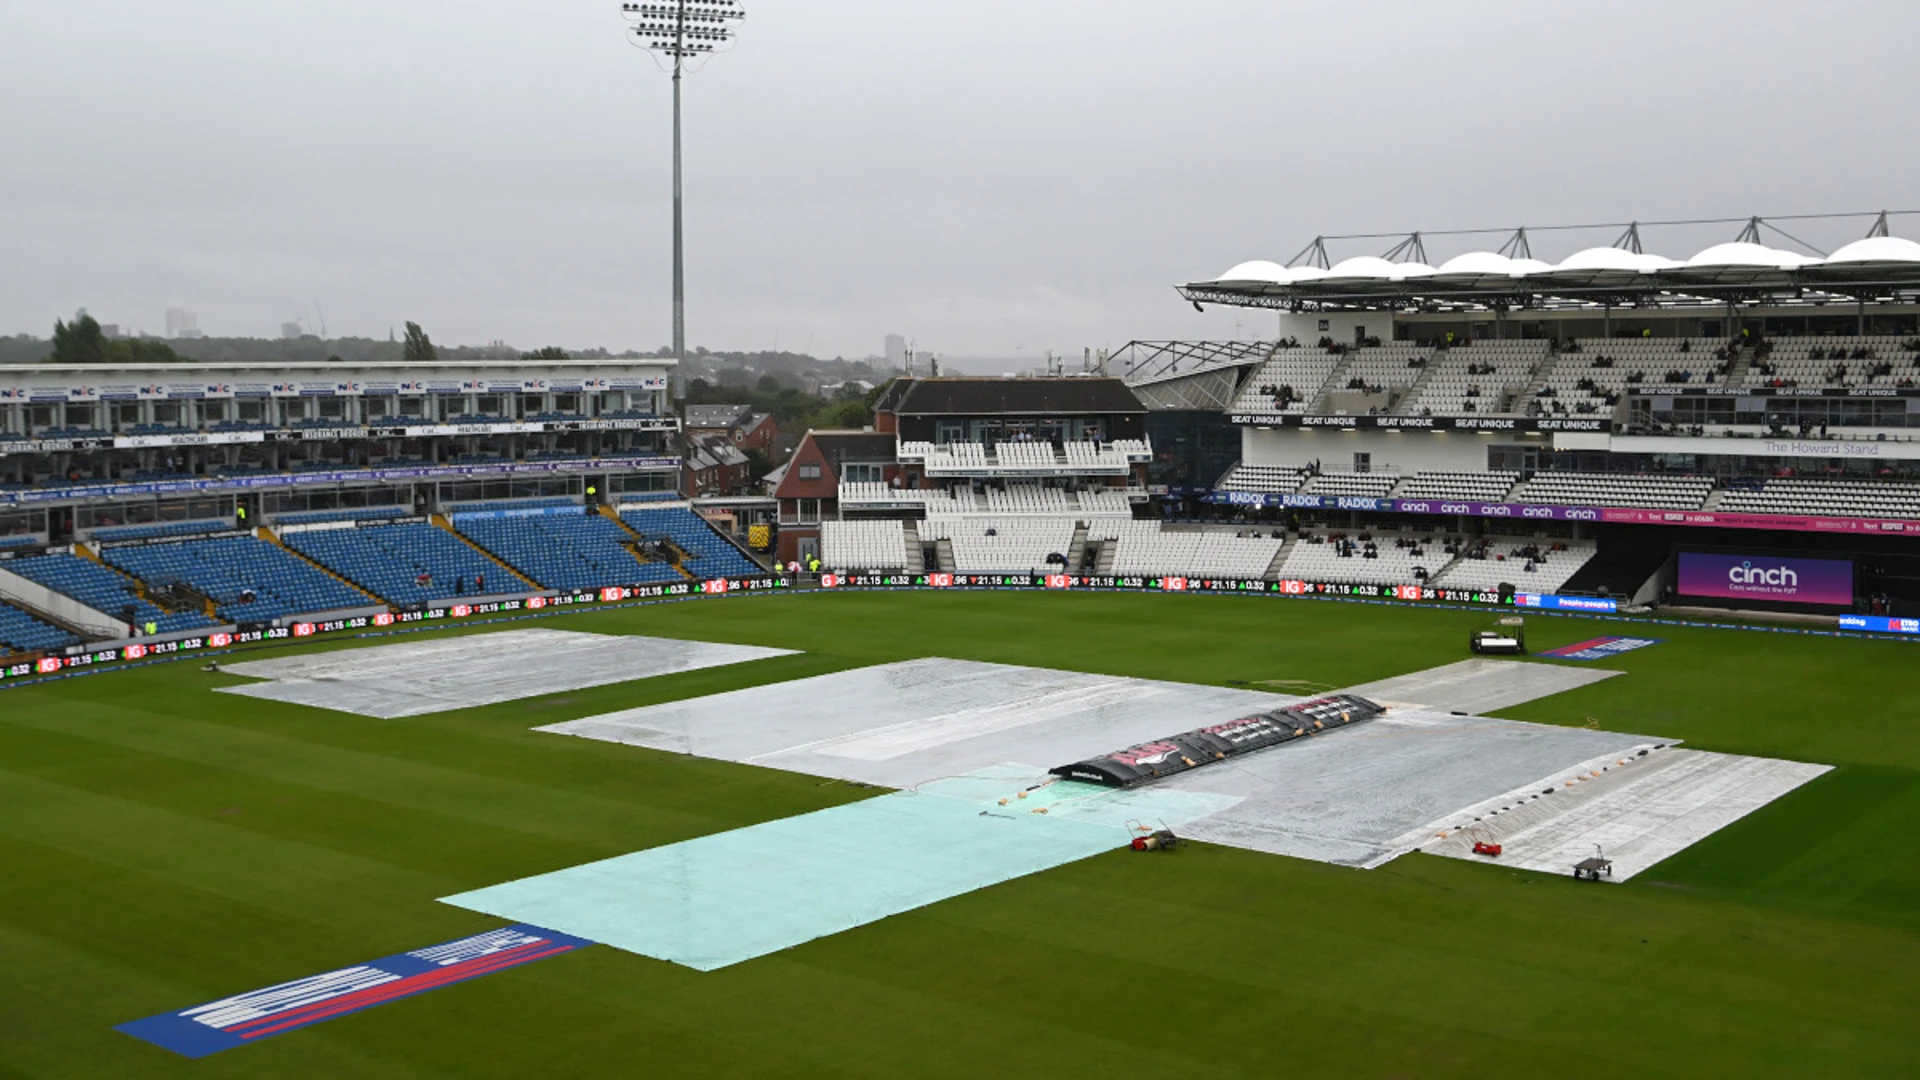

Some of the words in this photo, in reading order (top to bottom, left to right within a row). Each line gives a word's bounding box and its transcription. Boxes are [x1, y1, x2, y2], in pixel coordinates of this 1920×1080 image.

[1252, 416, 1283, 424] UNIQUE
[1325, 417, 1356, 426] UNIQUE
[1377, 418, 1399, 426] SEAT
[1400, 418, 1433, 427] UNIQUE
[1455, 419, 1478, 427] SEAT
[1480, 419, 1514, 428] UNIQUE
[1537, 420, 1562, 428] SEAT
[1563, 420, 1600, 430] UNIQUE
[1764, 441, 1787, 452] The
[1792, 443, 1839, 454] Howard
[1843, 444, 1879, 455] Stand
[1230, 492, 1266, 504] RADOX
[1283, 496, 1320, 506] RADOX
[1338, 498, 1377, 509] RADOX
[1401, 500, 1429, 512] cinch
[1441, 502, 1469, 514] cinch
[1481, 504, 1510, 516] cinch
[1523, 506, 1552, 518] cinch
[1565, 507, 1596, 520] cinch
[1729, 560, 1797, 586] cinch
[670, 584, 688, 594] 0.32
[750, 579, 772, 589] 21.15
[822, 575, 831, 587] G
[1089, 578, 1114, 586] 21.15
[1123, 578, 1142, 586] 0.32
[1212, 580, 1236, 589] 21.15
[1246, 581, 1264, 590] 0.32
[1324, 585, 1350, 594] 21.15
[1360, 586, 1378, 595] 0.32
[1446, 591, 1470, 601] 21.15
[1480, 593, 1499, 603] 0.32
